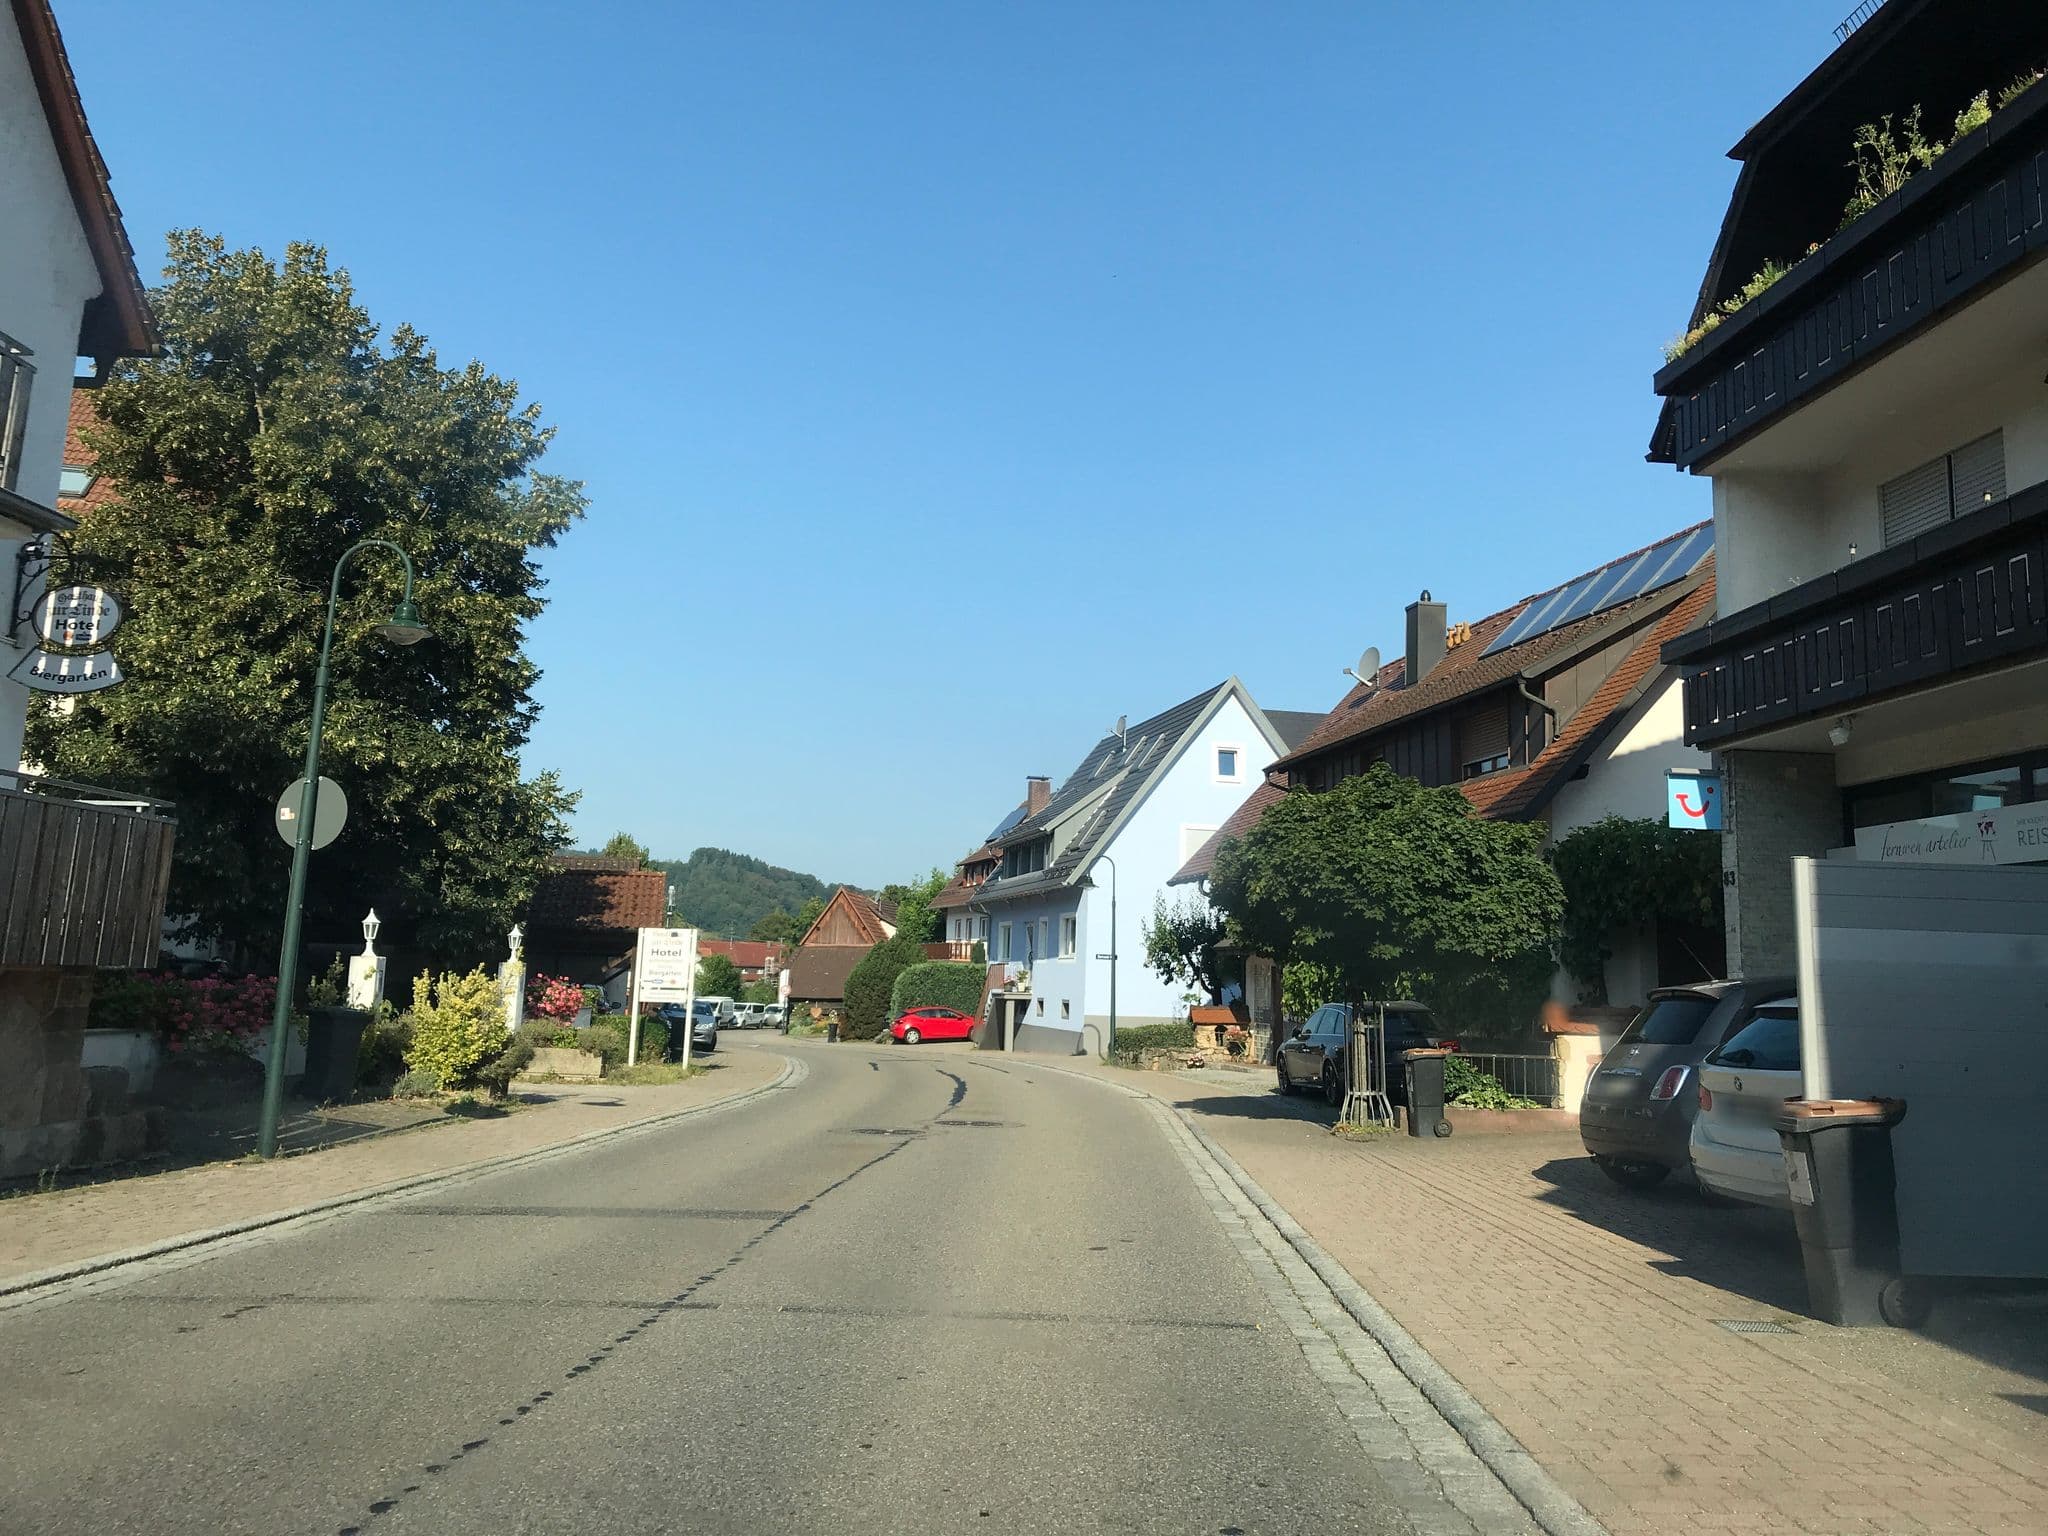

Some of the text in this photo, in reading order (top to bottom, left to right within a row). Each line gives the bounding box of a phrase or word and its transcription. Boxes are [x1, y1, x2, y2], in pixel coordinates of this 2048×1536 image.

[55, 619, 101, 630] Hotel
[30, 665, 108, 684] Biergarten
[651, 948, 682, 957] Hotel
